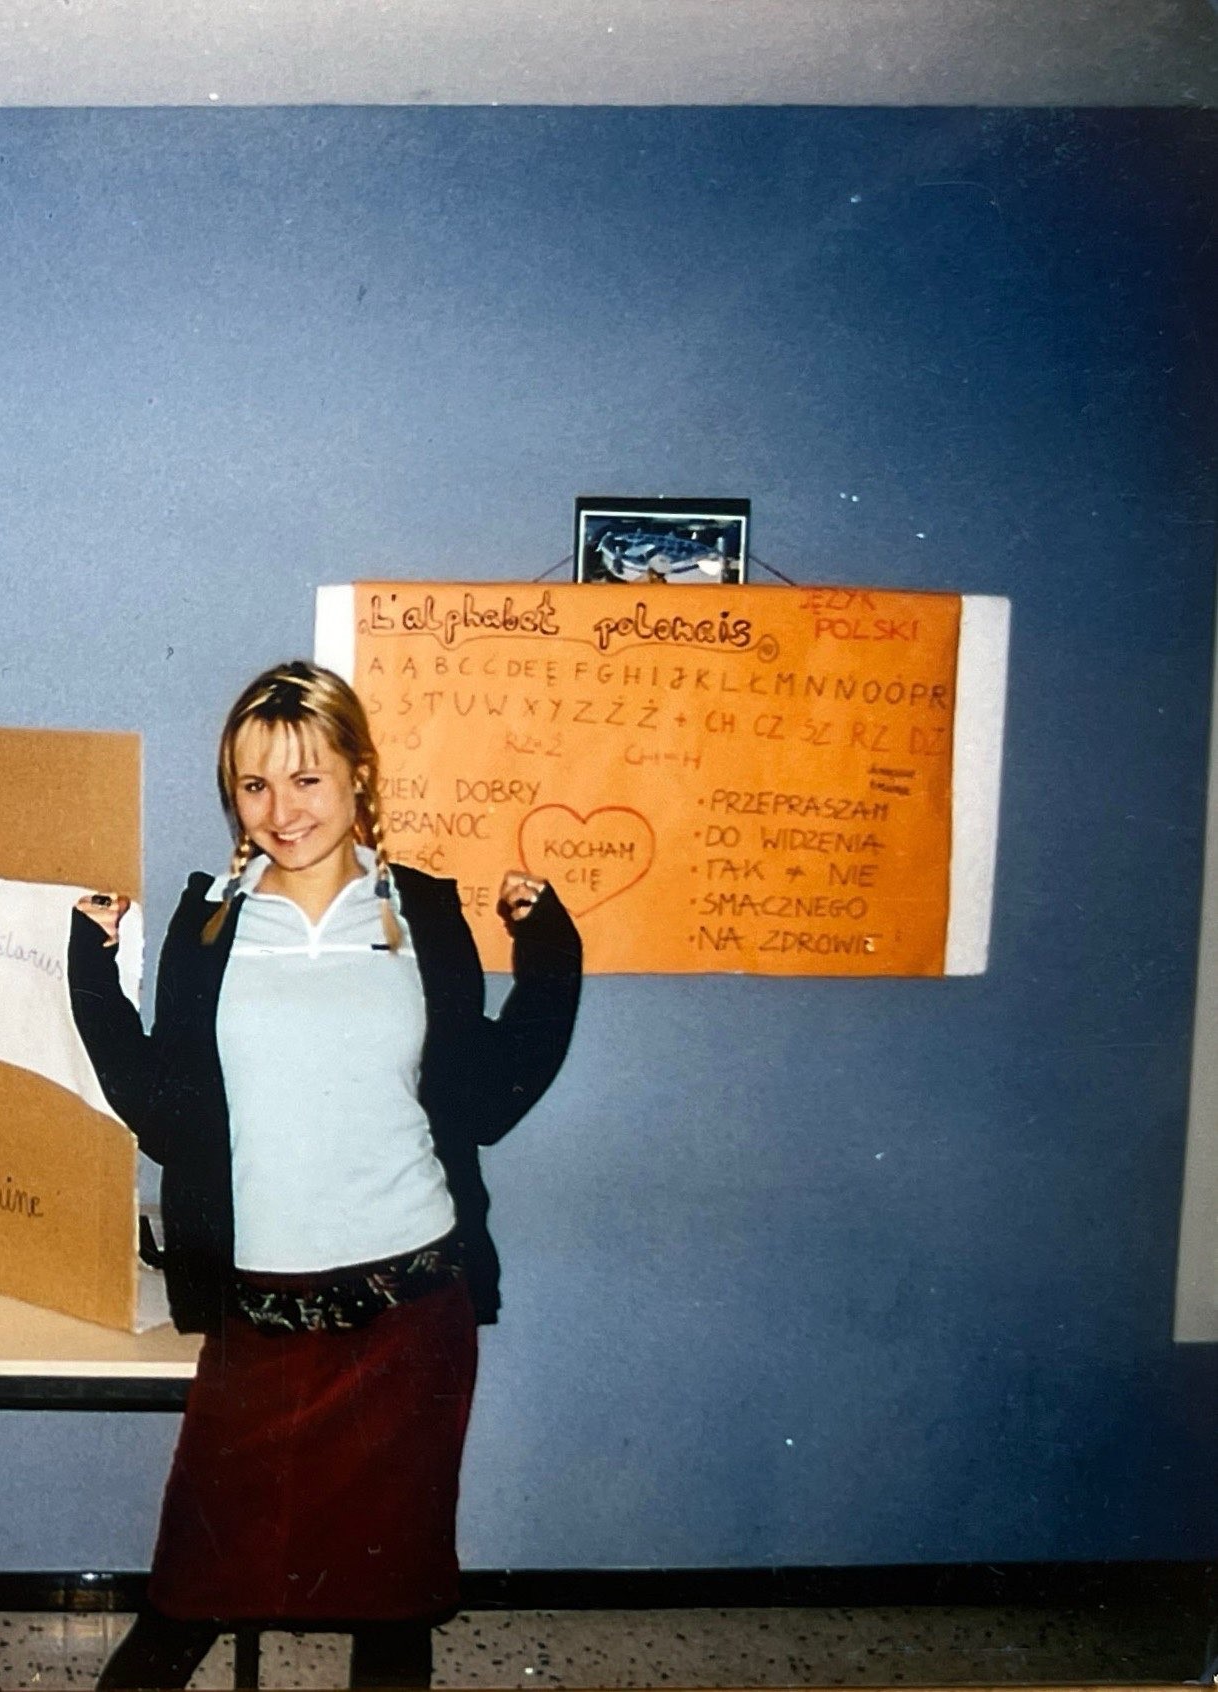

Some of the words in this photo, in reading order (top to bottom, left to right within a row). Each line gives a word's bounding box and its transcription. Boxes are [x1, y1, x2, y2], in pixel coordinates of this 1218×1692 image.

[371, 591, 560, 645] L'alphabet
[593, 601, 752, 650] polonais
[814, 618, 920, 642] POLSKI
[705, 710, 735, 733] CH
[753, 714, 784, 740] CZ
[378, 774, 429, 799] ZIEŃ
[455, 779, 542, 805] DOBRY
[711, 789, 888, 821] PRZEPRASZAM
[380, 810, 493, 840] OBRANOC
[705, 825, 740, 848] DO
[760, 826, 885, 853] WIDZENIA
[544, 839, 635, 862] KOCHAM
[565, 868, 601, 892] CIĘ
[706, 859, 766, 881] TAK
[828, 863, 879, 887] NIE
[699, 892, 868, 919] SMACZNEGO
[698, 926, 745, 951] NA
